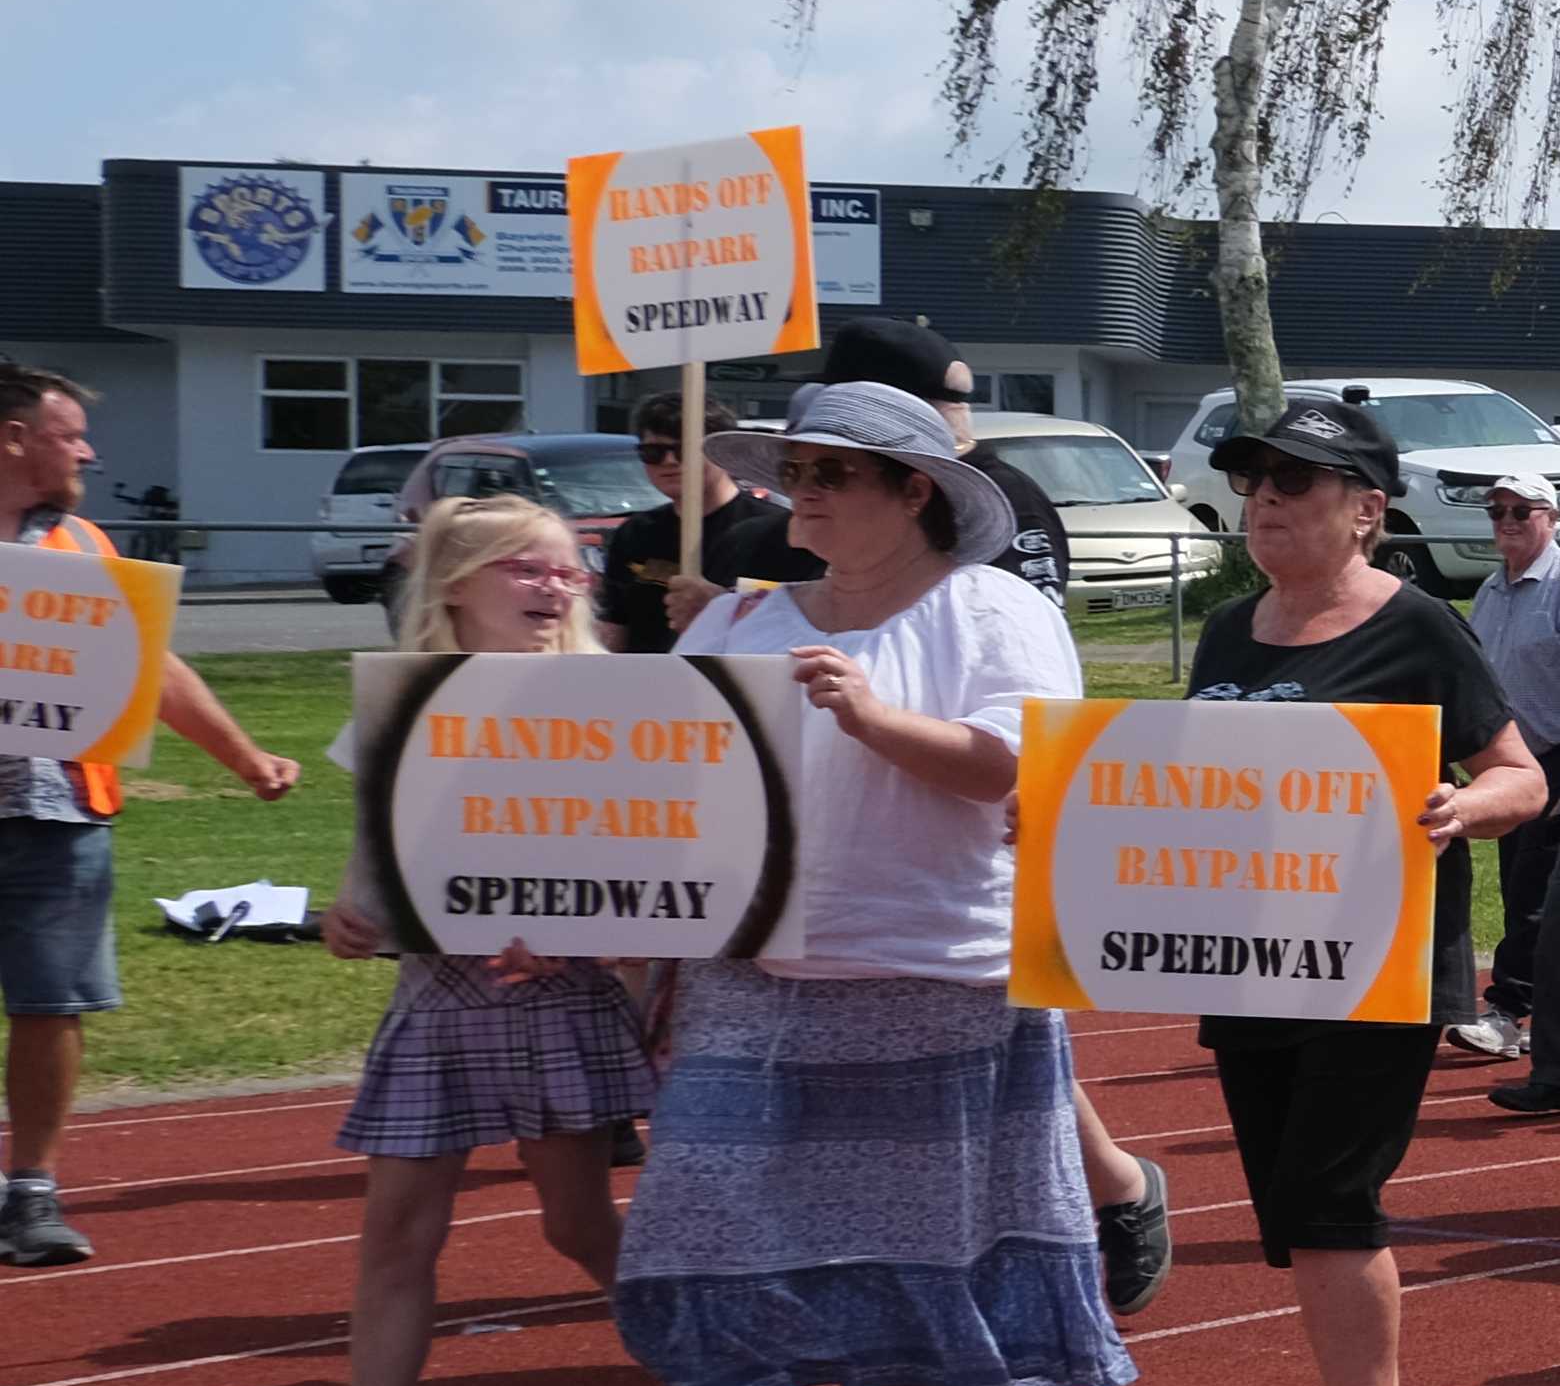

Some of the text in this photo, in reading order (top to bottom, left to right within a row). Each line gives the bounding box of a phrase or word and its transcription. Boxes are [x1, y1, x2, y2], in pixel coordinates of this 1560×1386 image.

[608, 170, 774, 223] HANDS OFF
[820, 199, 871, 218] INC.
[630, 233, 757, 274] BAYPARK
[626, 289, 768, 334] SPEEDWAY
[24, 589, 120, 627] OFF
[429, 715, 735, 765] HANDS OFF
[1089, 761, 1378, 816] HANDS OFF
[462, 796, 699, 840] BAYPARK
[1116, 846, 1339, 893] BAYPARK
[446, 875, 715, 920] SPEEDWAY
[1101, 931, 1354, 980] SPEEDWAY
